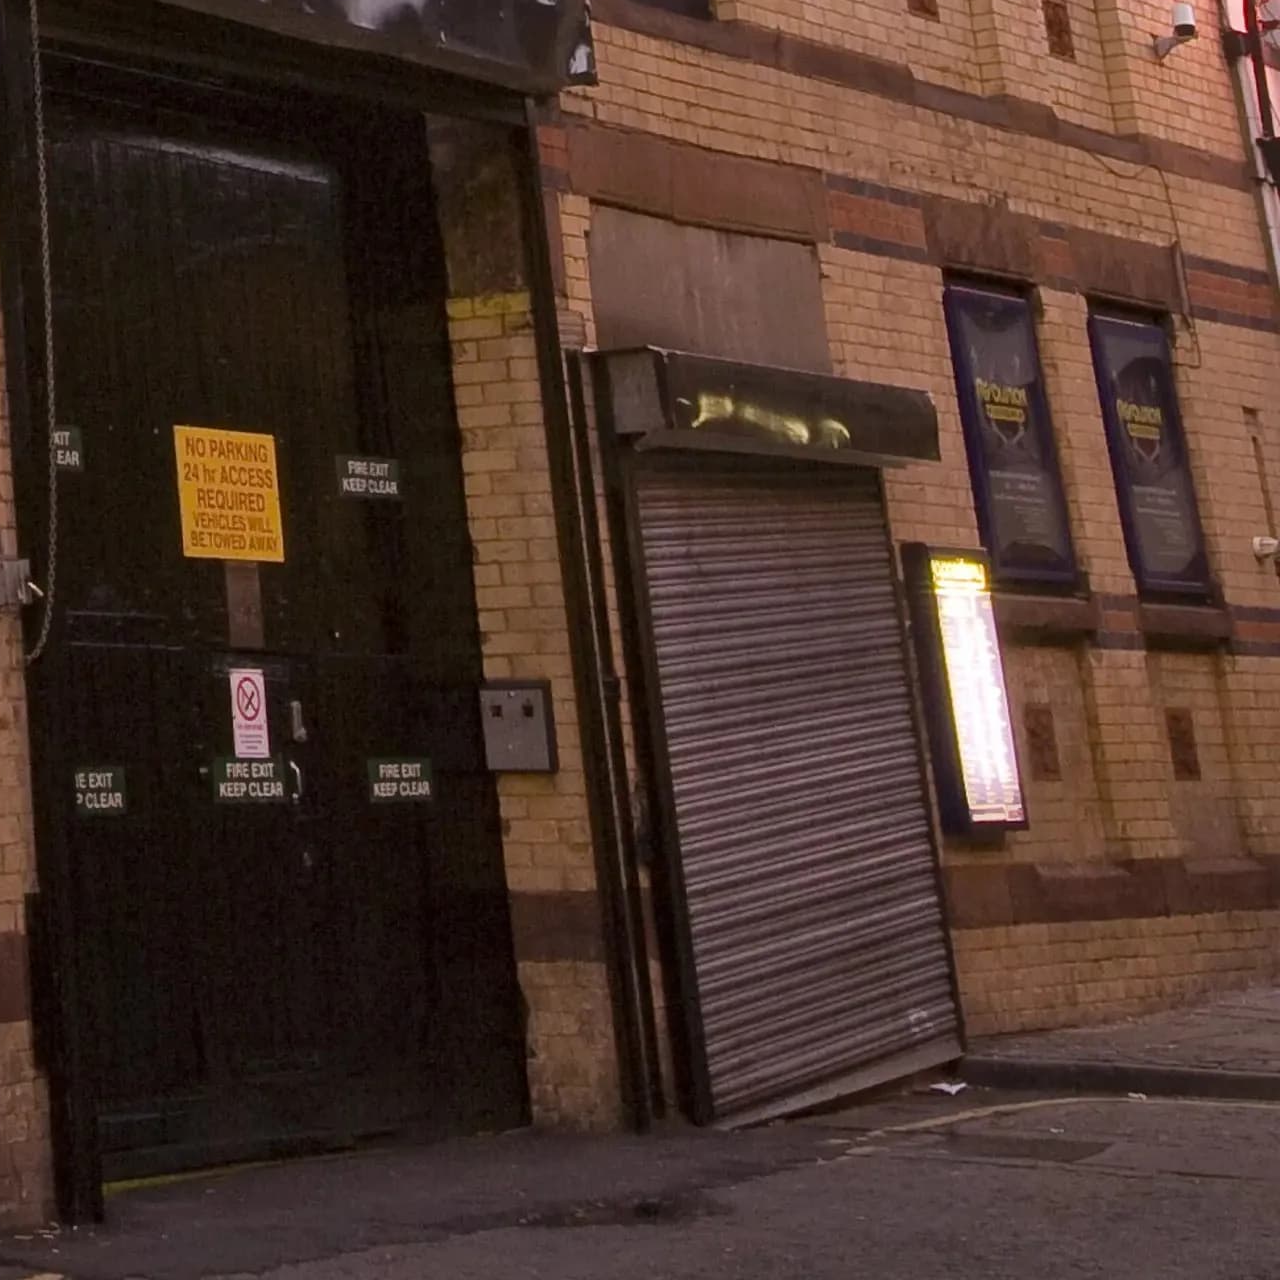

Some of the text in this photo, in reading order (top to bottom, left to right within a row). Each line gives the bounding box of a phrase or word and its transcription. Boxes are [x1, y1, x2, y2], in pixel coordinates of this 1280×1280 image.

[53, 431, 71, 446] XIT
[185, 436, 268, 463] NO PARKING
[184, 462, 273, 489] 24 hr ACCESS
[348, 460, 389, 477] FIRE EXIT
[342, 477, 398, 494] KEEP CLEAR
[197, 488, 265, 512] REQUIRED
[193, 511, 273, 534] VEHICLES WILL
[191, 530, 279, 552] BE TOWED AWAY
[226, 762, 274, 778] FIRE EXIT
[379, 763, 421, 779] FIRE EXIT
[88, 772, 113, 788] EXIT
[219, 782, 283, 797] KEEP CLEAR
[373, 781, 430, 797] KEEP CLEAR
[85, 792, 123, 809] CLEAR
